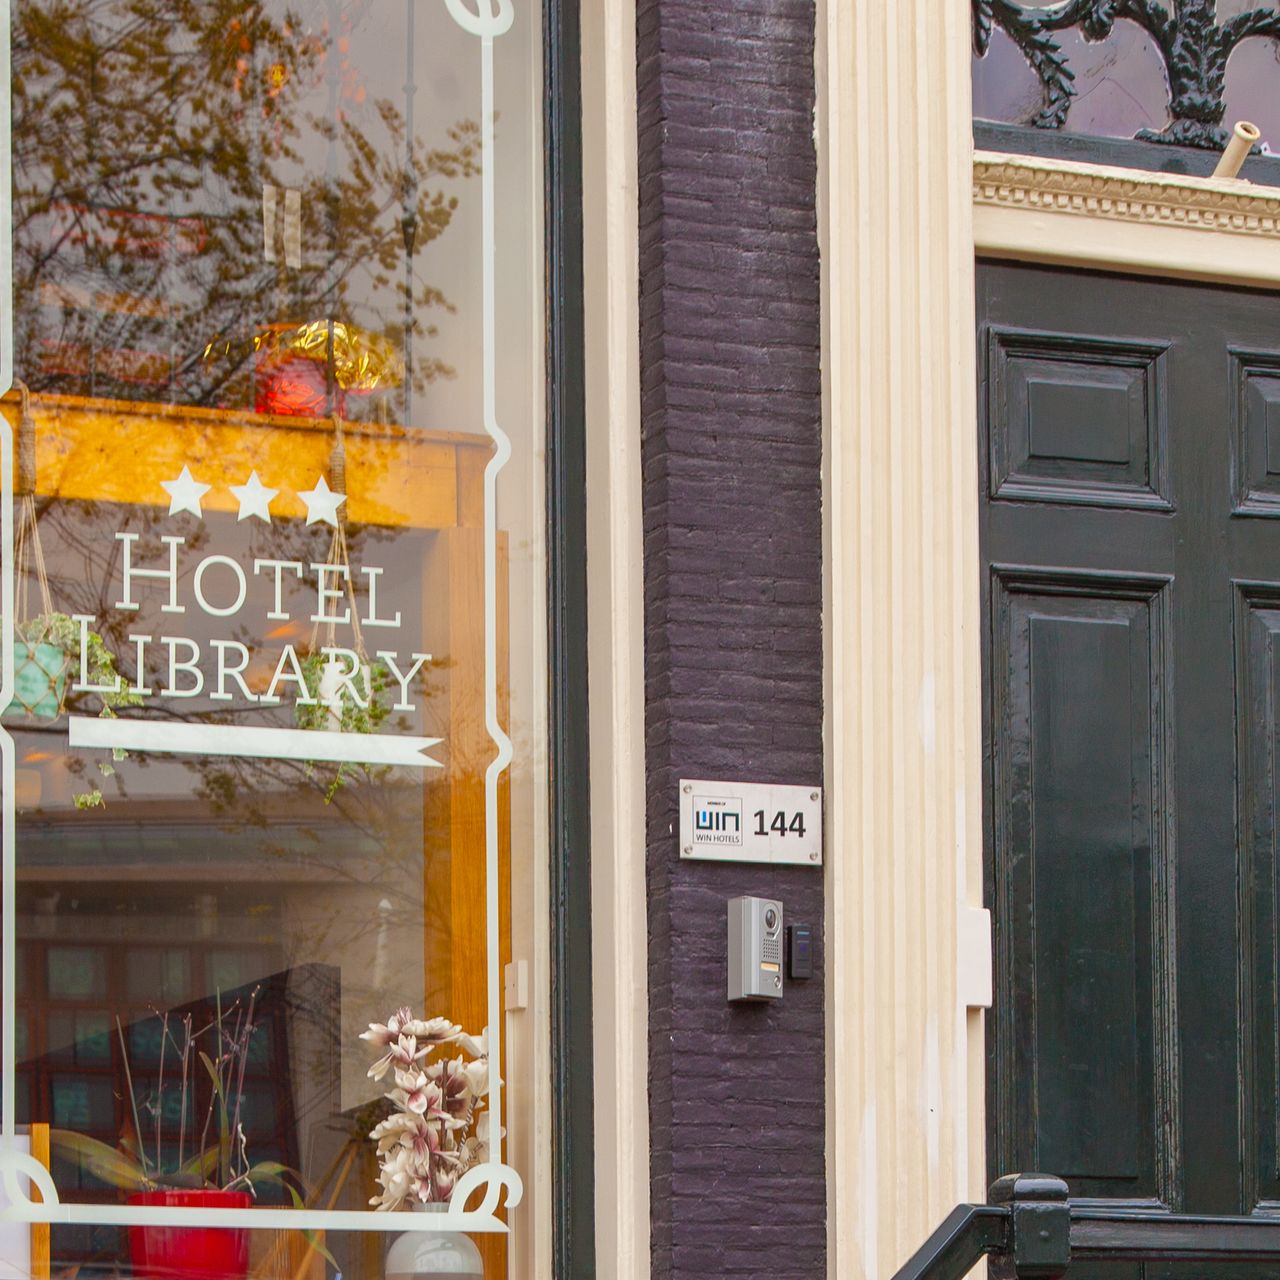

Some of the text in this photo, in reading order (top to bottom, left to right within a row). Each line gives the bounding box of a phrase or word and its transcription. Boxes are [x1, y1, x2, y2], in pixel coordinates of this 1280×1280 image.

[114, 532, 402, 627] HOTEL
[71, 614, 433, 712] LIBRARY
[696, 833, 740, 844] WIN HOTELS
[753, 809, 807, 838] 144
